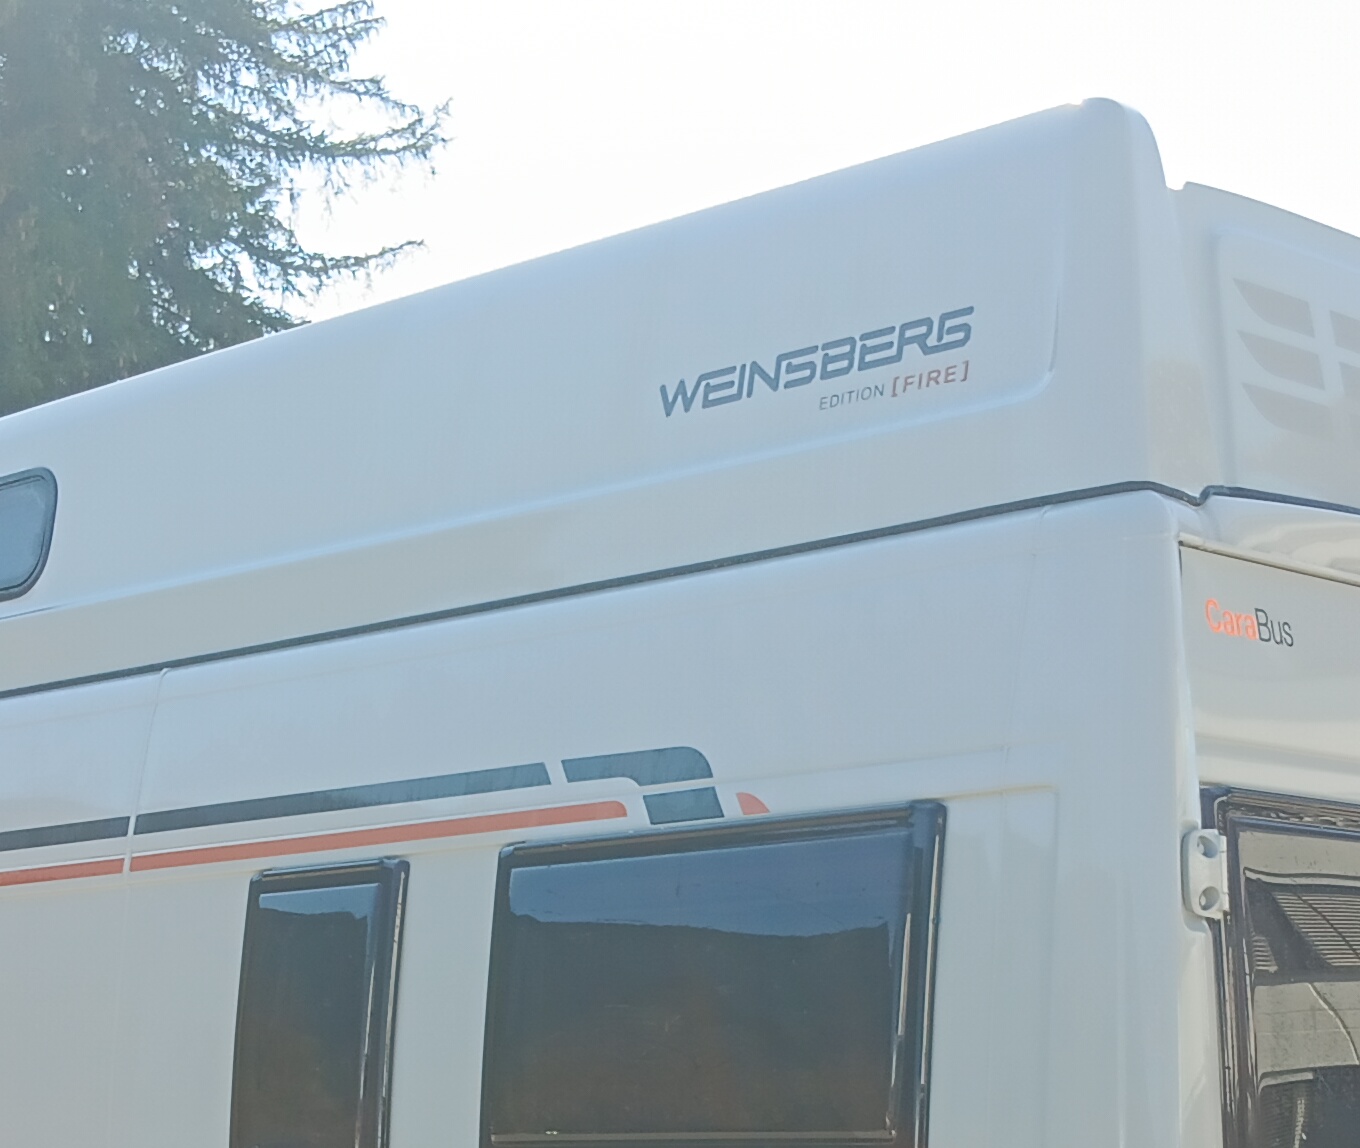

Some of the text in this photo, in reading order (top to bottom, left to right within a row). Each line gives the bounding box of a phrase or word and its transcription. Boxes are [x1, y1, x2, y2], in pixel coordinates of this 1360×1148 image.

[659, 305, 975, 418] WEINSBERG
[818, 360, 971, 411] EDITION [FIRE]
[1204, 598, 1294, 647] CaraBus
